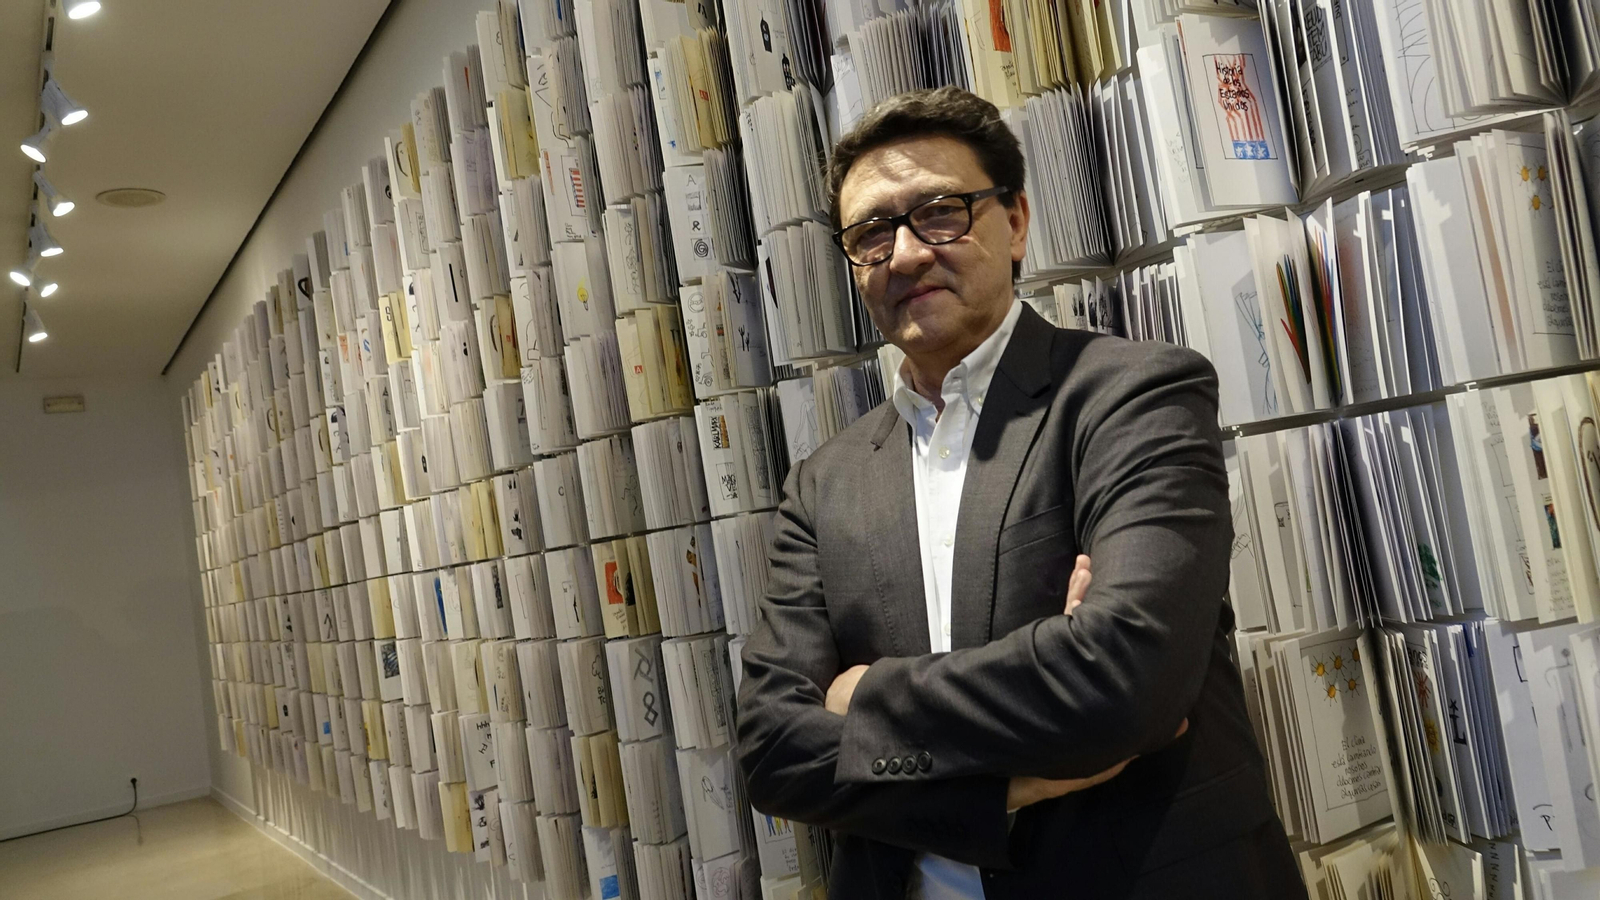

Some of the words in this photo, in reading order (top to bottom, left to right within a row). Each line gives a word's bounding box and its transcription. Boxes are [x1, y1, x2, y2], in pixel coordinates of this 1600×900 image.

[1304, 5, 1323, 31] EUD
[1215, 62, 1243, 76] Historia
[1219, 88, 1250, 99] Estados
[1222, 99, 1249, 111] Unidos
[686, 174, 697, 187] A
[1341, 737, 1350, 751] El
[1351, 735, 1366, 748] clima
